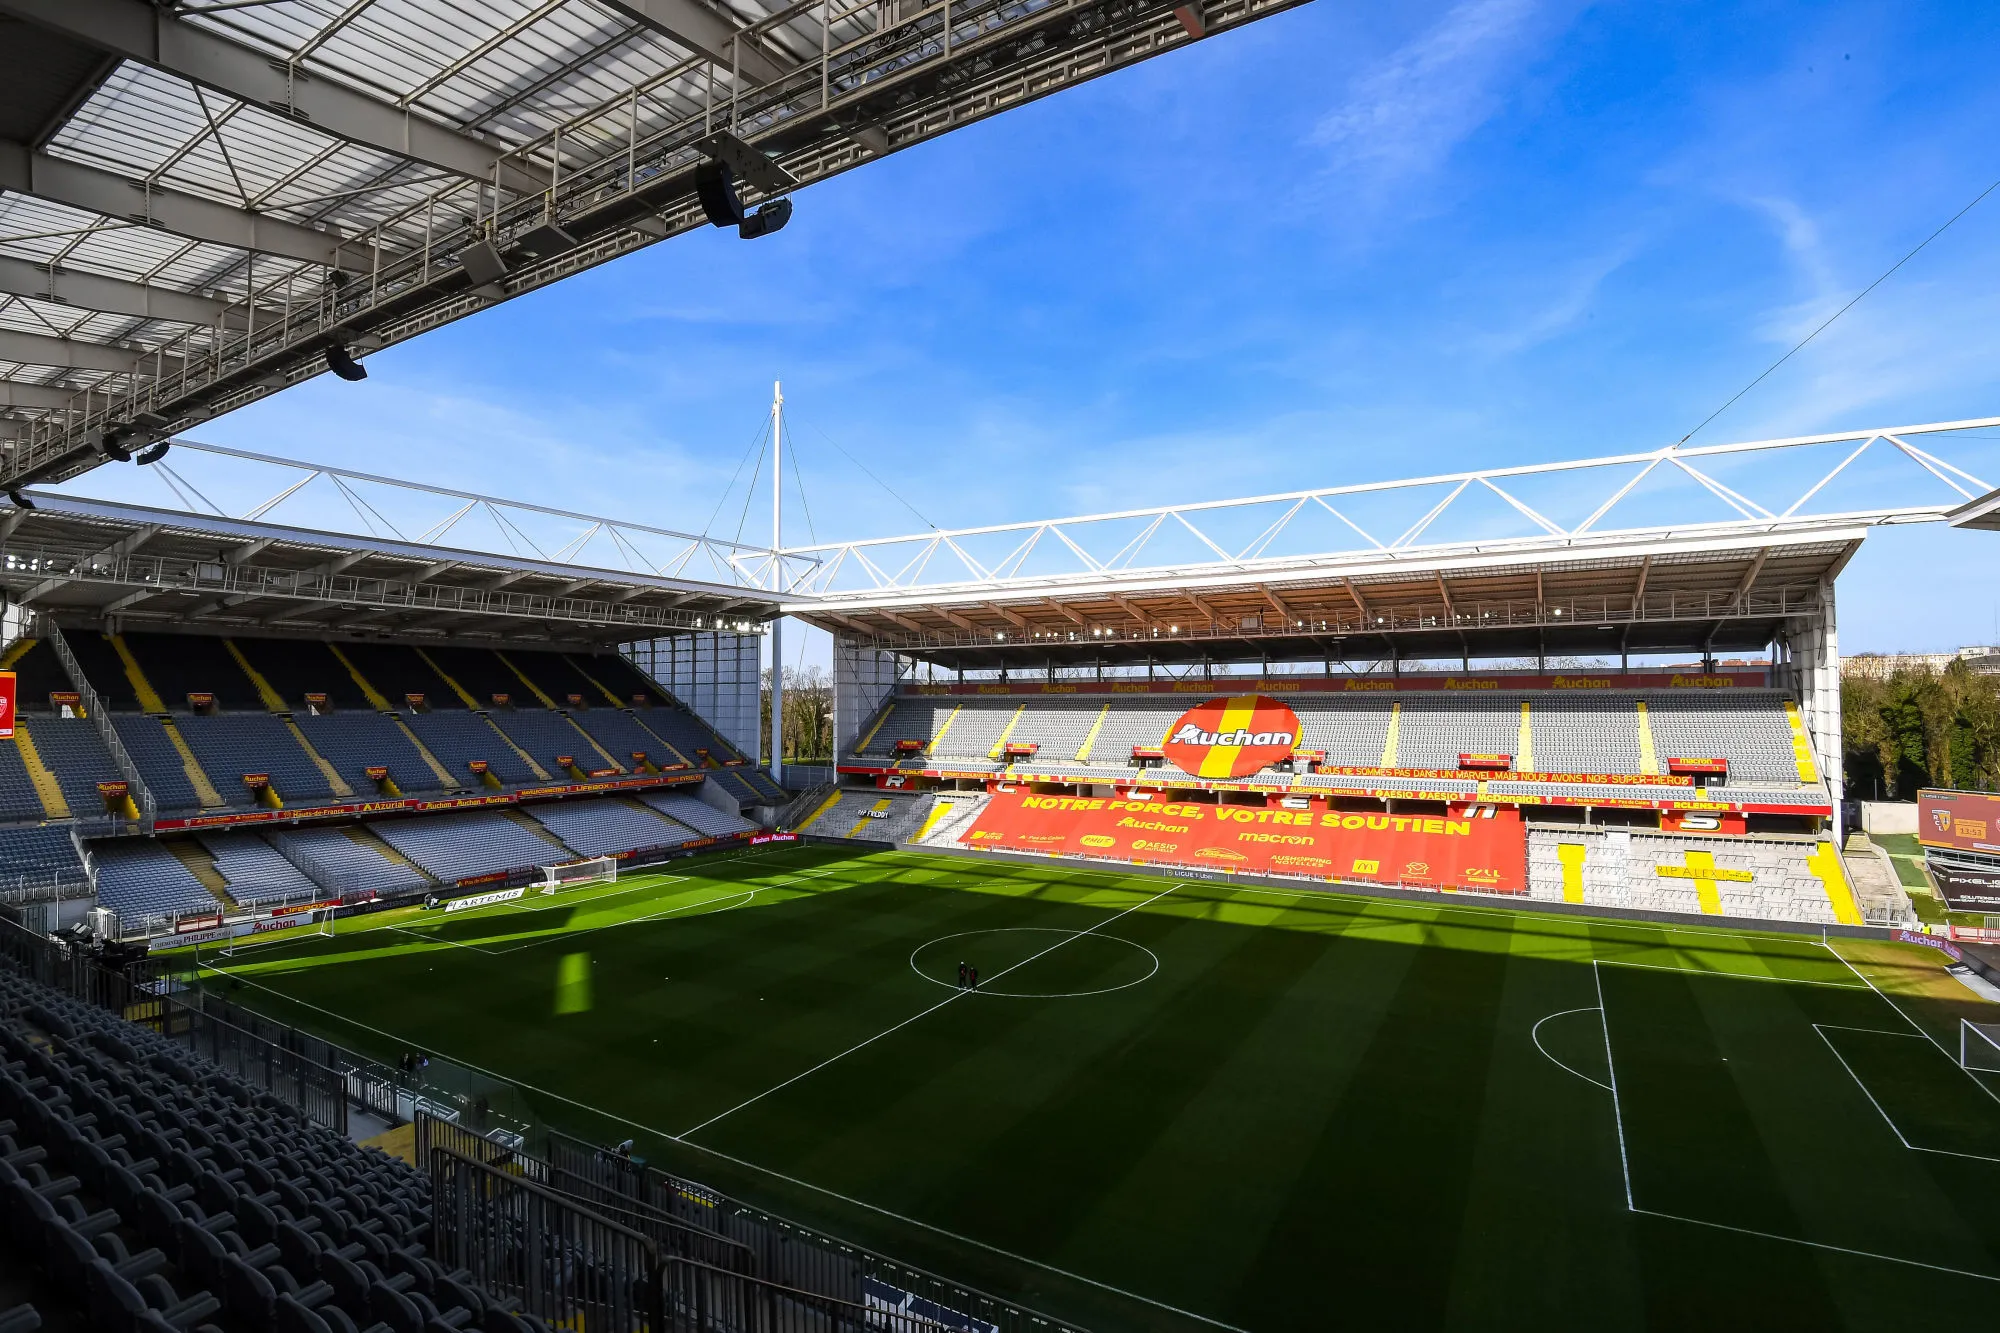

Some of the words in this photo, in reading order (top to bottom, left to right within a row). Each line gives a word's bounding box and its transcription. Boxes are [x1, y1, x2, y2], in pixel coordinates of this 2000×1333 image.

[1256, 680, 1300, 691] Auchan
[1345, 678, 1394, 690] Auchan
[1444, 677, 1498, 689] Auchan
[1552, 676, 1610, 688] Auchan
[1670, 674, 1733, 687] Auchan
[1112, 683, 1149, 693] Auchan
[1173, 681, 1214, 692] Auchan
[1170, 723, 1293, 746] Auchan
[1318, 767, 1340, 775] NOUS
[1356, 768, 1392, 776] SOMMES
[1394, 769, 1411, 777] PAS
[1414, 770, 1437, 778] DANS
[1521, 773, 1548, 781] NOUS
[1551, 773, 1583, 782] AVONS
[1586, 774, 1608, 783] NOS
[1211, 782, 1239, 790] Auchan
[1248, 784, 1277, 792] Auchan
[374, 800, 405, 810] Azurial
[1674, 802, 1729, 810] RCLENS.FR
[293, 808, 344, 817] Hauts-de-France
[1021, 796, 1106, 811] NOTRE
[1108, 801, 1204, 820] FORCE,
[1215, 808, 1314, 826] VOTRE
[1320, 814, 1471, 836] SOUTIEN
[1116, 816, 1189, 834] Auchan
[1238, 832, 1315, 846] macron
[1271, 855, 1332, 865] AUSHOPPING
[1275, 860, 1324, 868] NOYELLES
[1657, 865, 1678, 875] RIP
[460, 890, 519, 906] ARTEMIS
[252, 919, 296, 934] Auchan
[184, 932, 216, 943] PHILIPPE
[1900, 930, 1942, 949] Auchan
